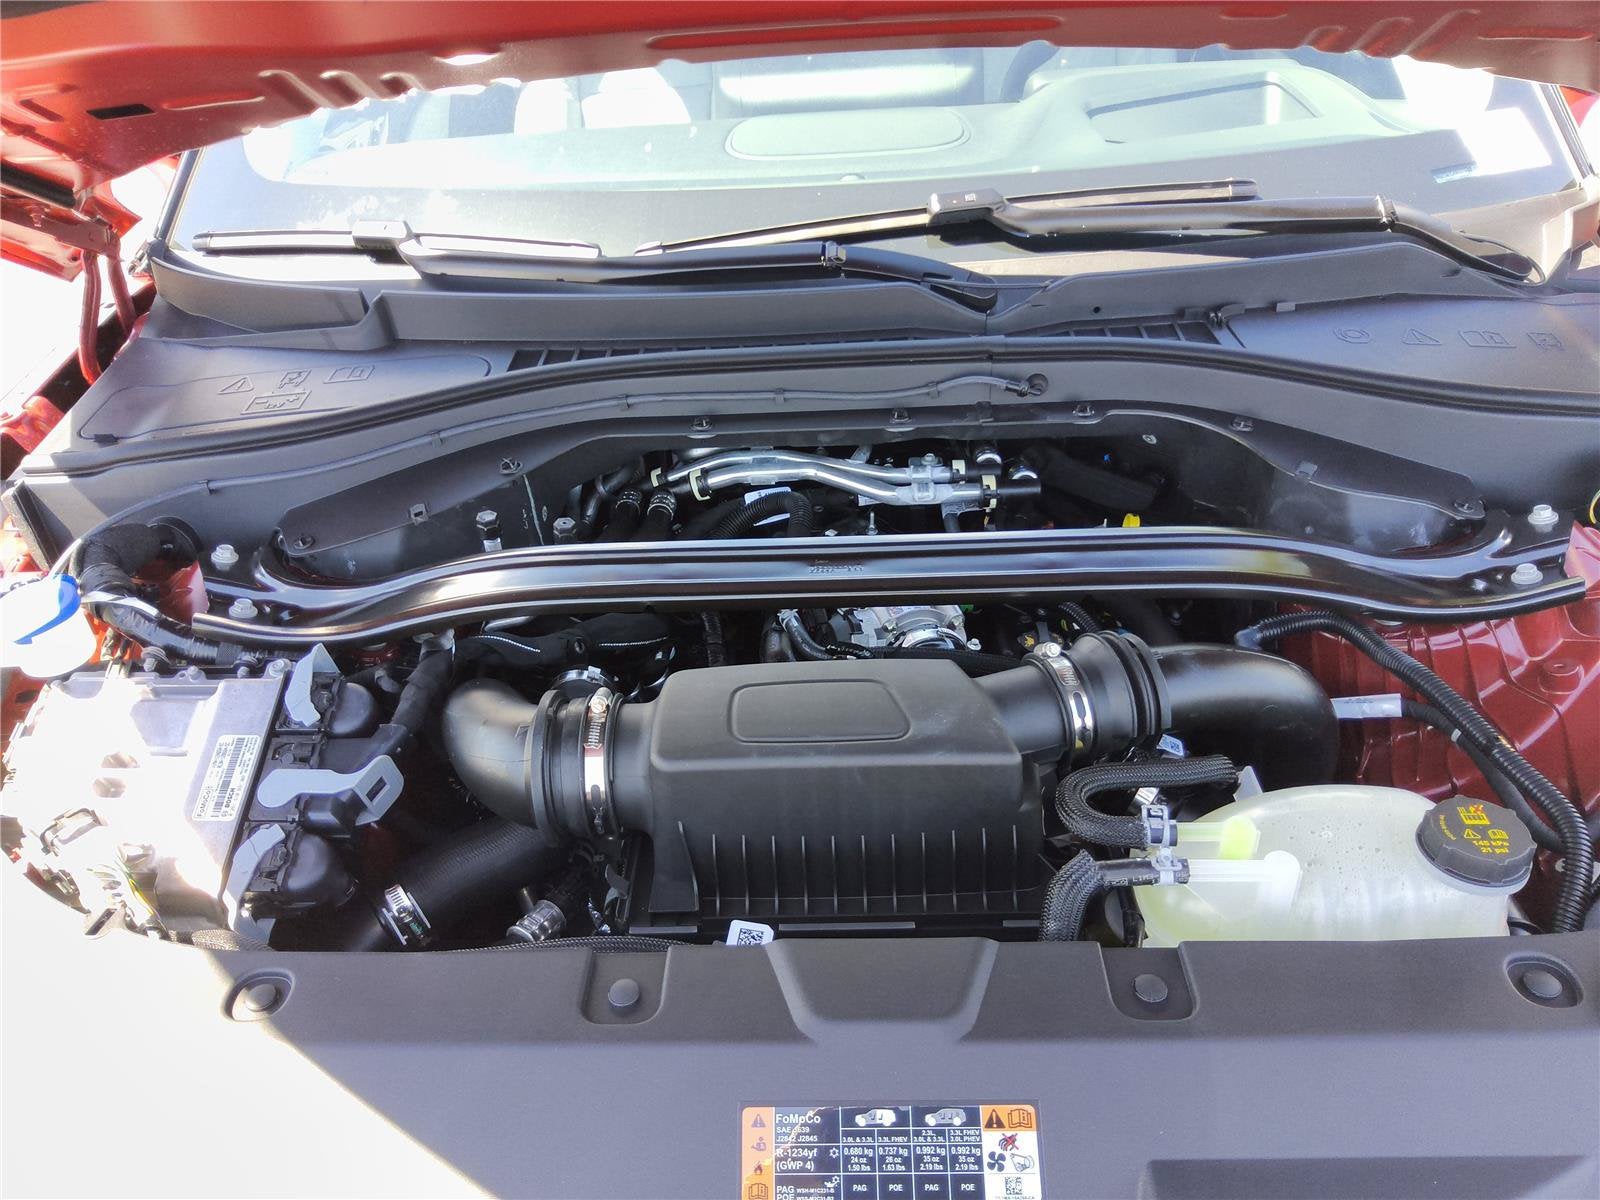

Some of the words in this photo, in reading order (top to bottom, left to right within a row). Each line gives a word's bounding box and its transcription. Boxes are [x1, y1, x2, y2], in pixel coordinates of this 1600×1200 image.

[225, 787, 236, 809] BOSCH
[775, 1148, 818, 1159] R-1234yf
[843, 1147, 862, 1155] 0.680
[863, 1147, 874, 1157] kg
[878, 1147, 898, 1155] 0.737
[898, 1147, 908, 1156] kg
[915, 1146, 936, 1155] 0.992
[936, 1146, 946, 1156] kg
[950, 1146, 971, 1155] 0.992
[971, 1146, 981, 1156] kg
[776, 1161, 803, 1172] (GWP
[804, 1161, 815, 1172] 4)
[776, 1185, 795, 1194] PAG
[852, 1184, 867, 1192] PAG
[888, 1184, 904, 1192] POE
[924, 1184, 940, 1192] PAG
[960, 1183, 976, 1191] POE
